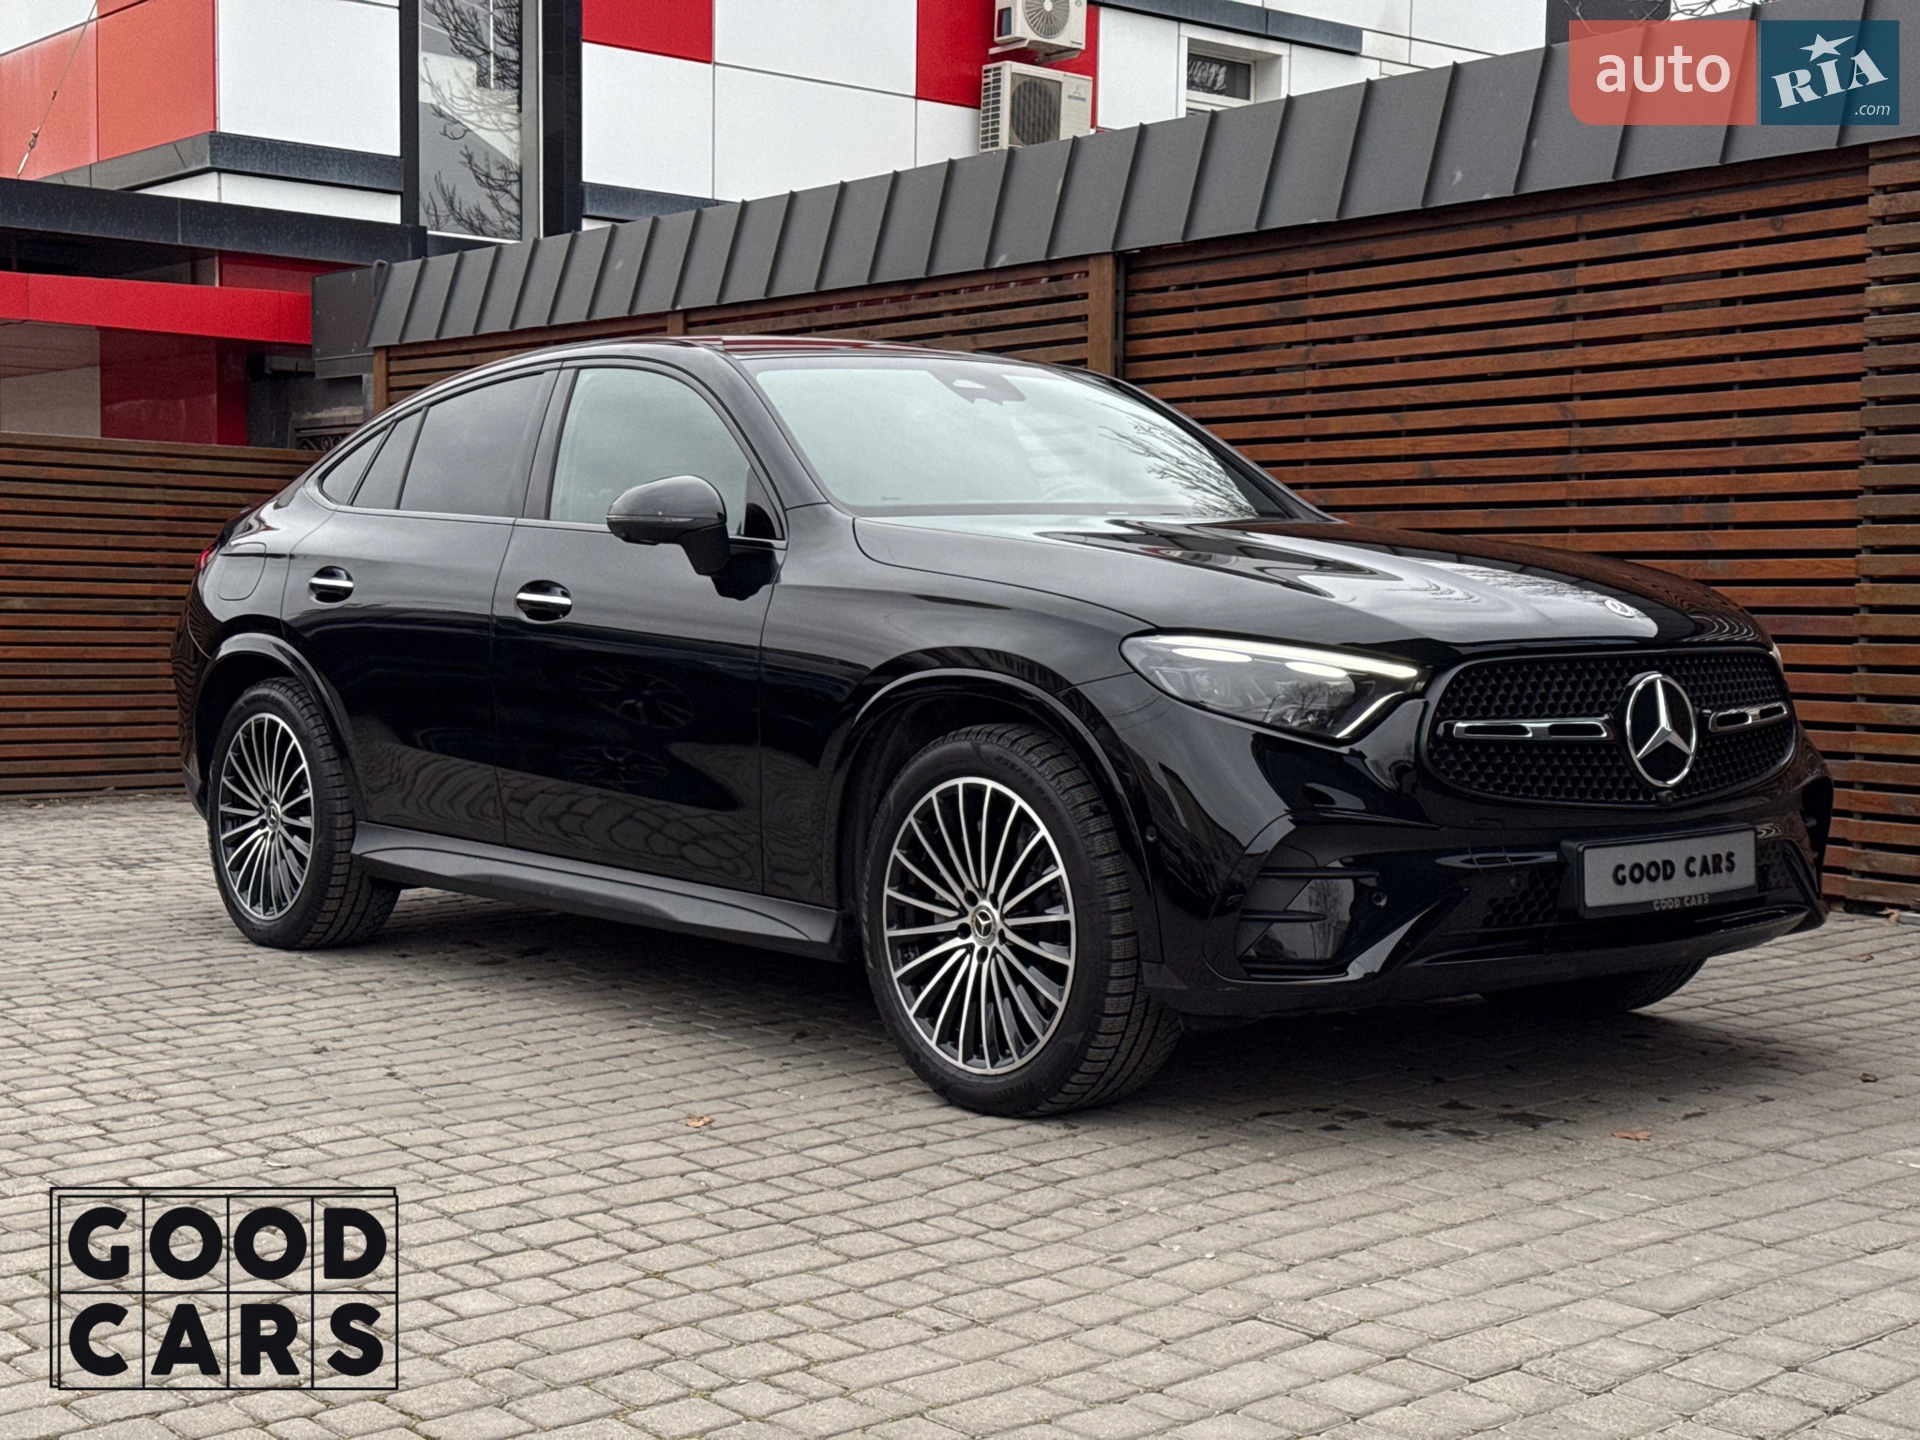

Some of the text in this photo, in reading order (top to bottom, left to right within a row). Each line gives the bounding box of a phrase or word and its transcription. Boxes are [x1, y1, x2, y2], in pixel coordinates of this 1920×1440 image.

[1612, 851, 1736, 886] GOOD CARS
[1653, 893, 1710, 912] GOOD CARS
